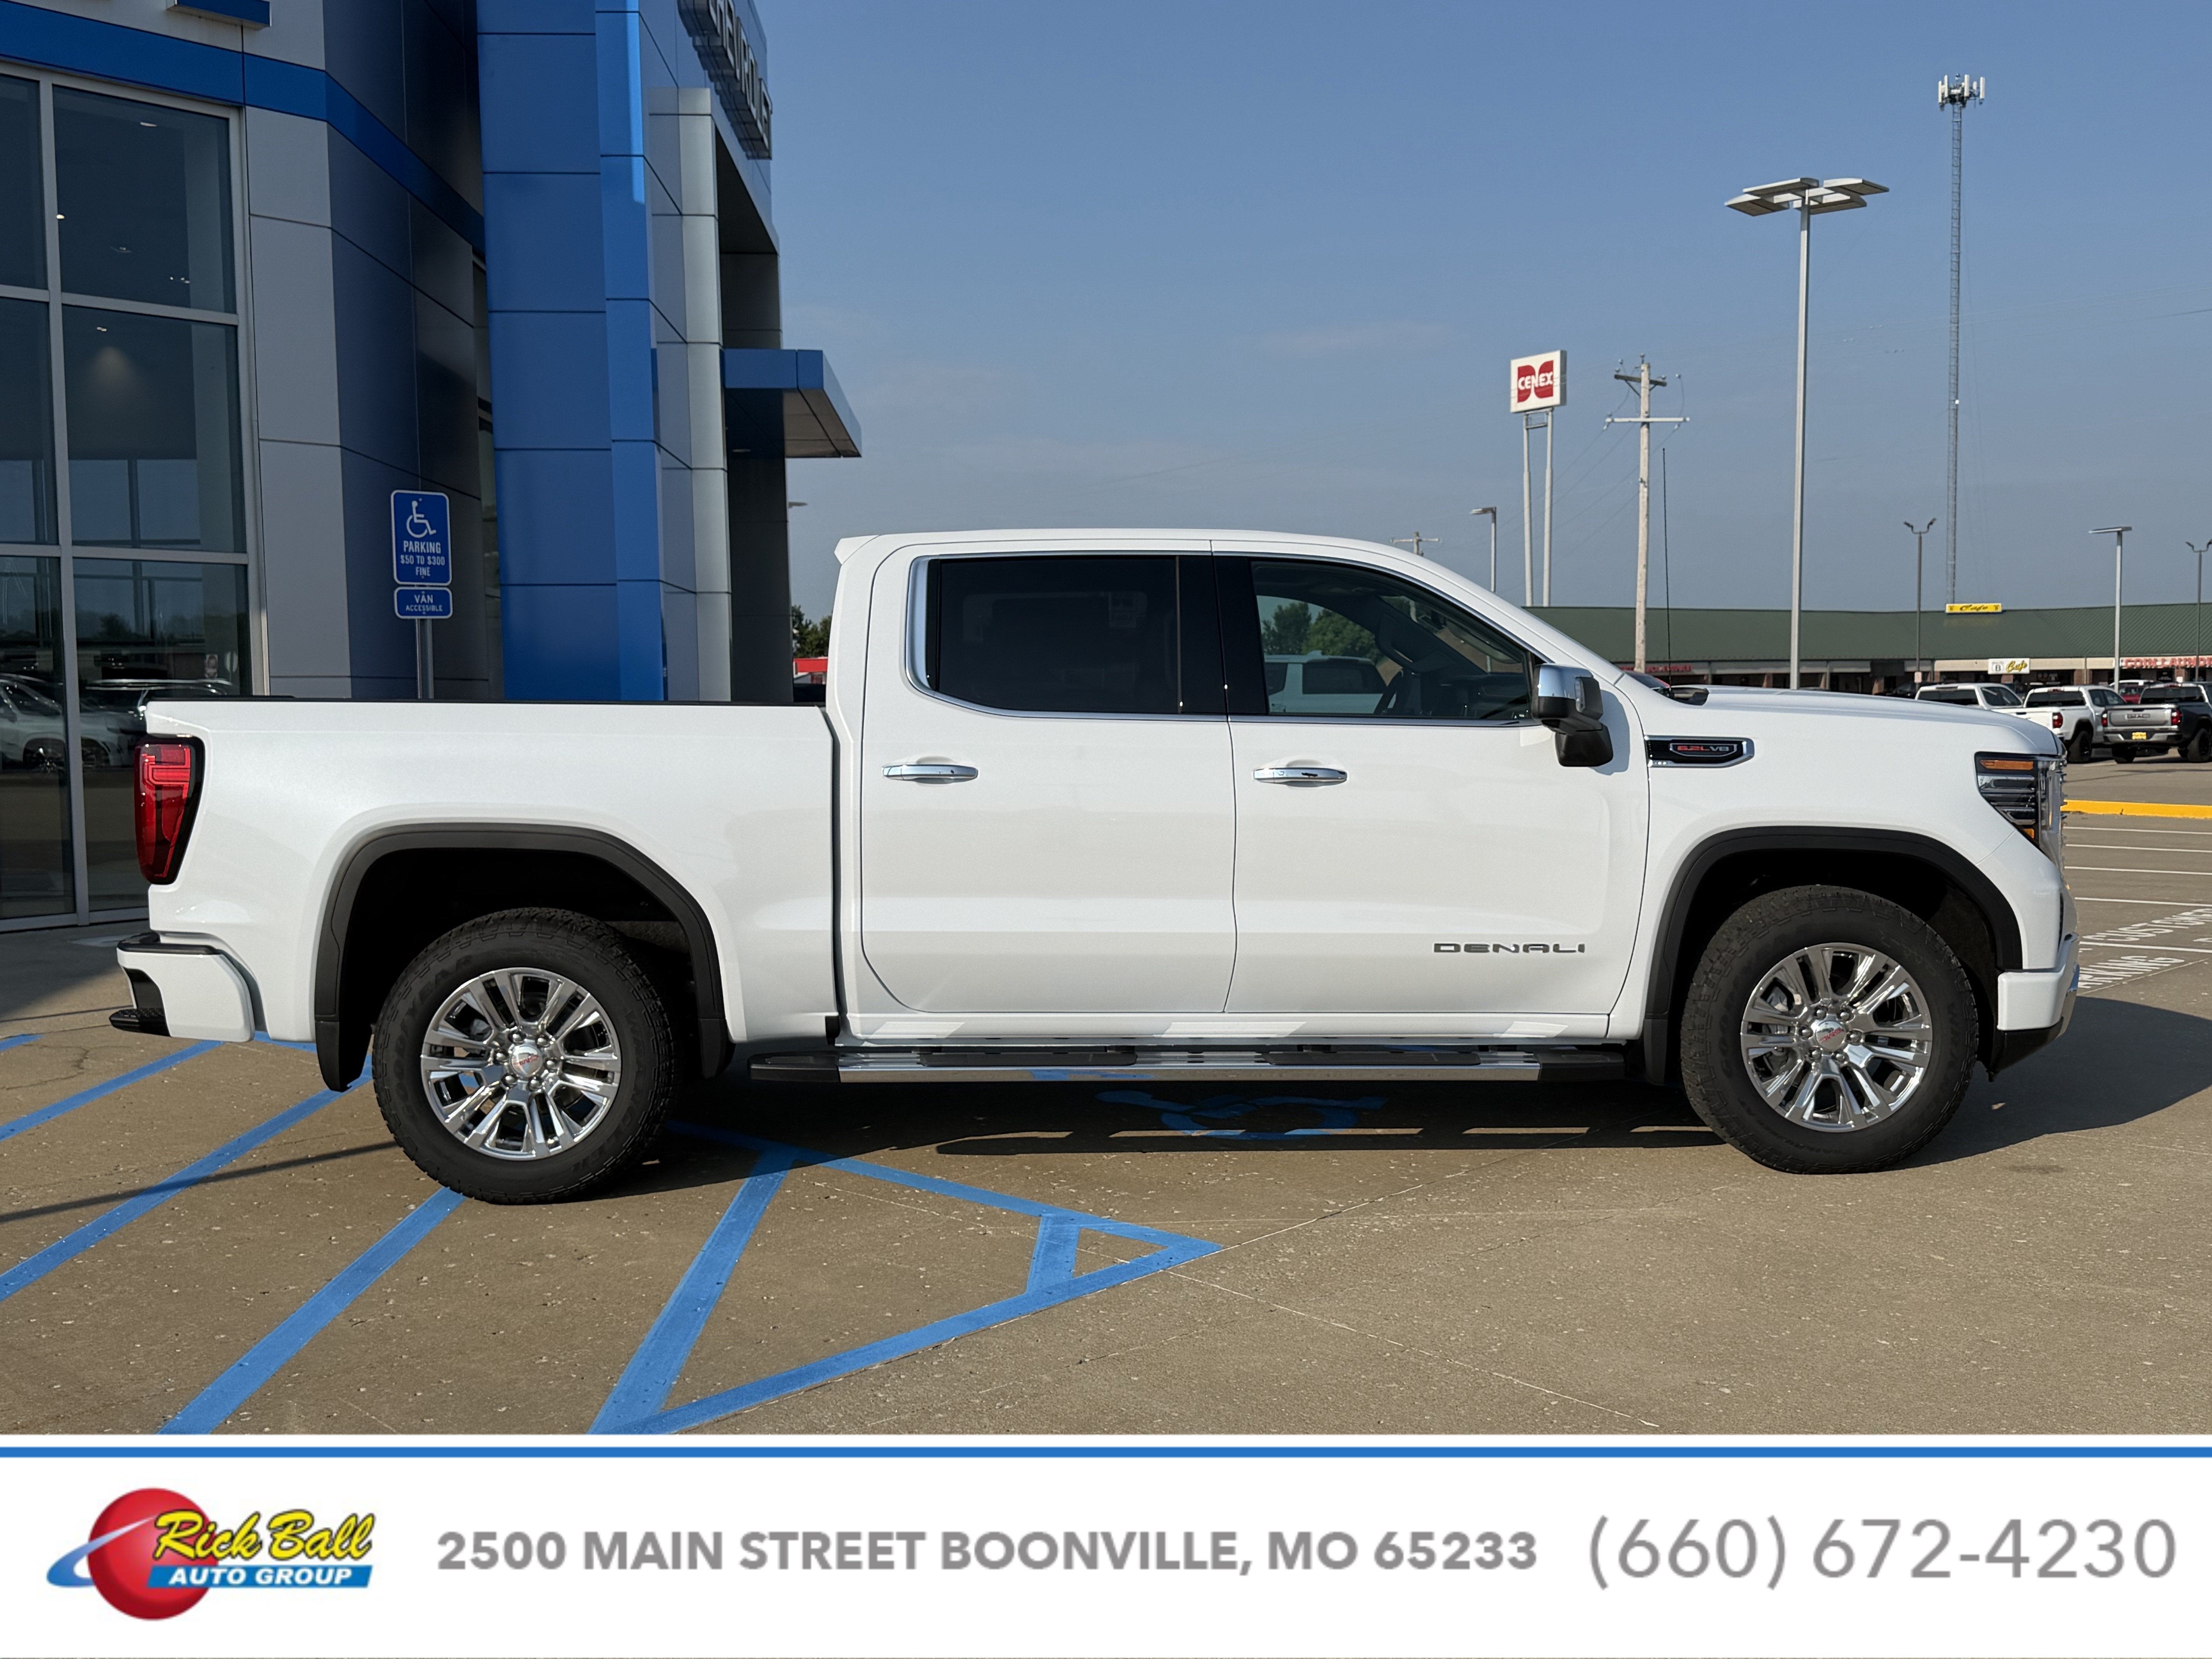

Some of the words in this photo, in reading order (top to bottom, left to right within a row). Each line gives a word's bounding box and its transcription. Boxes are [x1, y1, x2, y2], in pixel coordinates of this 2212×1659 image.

[1518, 372, 1553, 390] CENEX
[403, 541, 441, 554] PARKING
[400, 555, 414, 564] $50
[416, 555, 425, 565] TO
[427, 556, 445, 566] $300
[415, 567, 431, 576] FINE
[414, 594, 433, 604] VAN
[2124, 658, 2157, 668] COIN
[1434, 943, 1585, 953] DENALI
